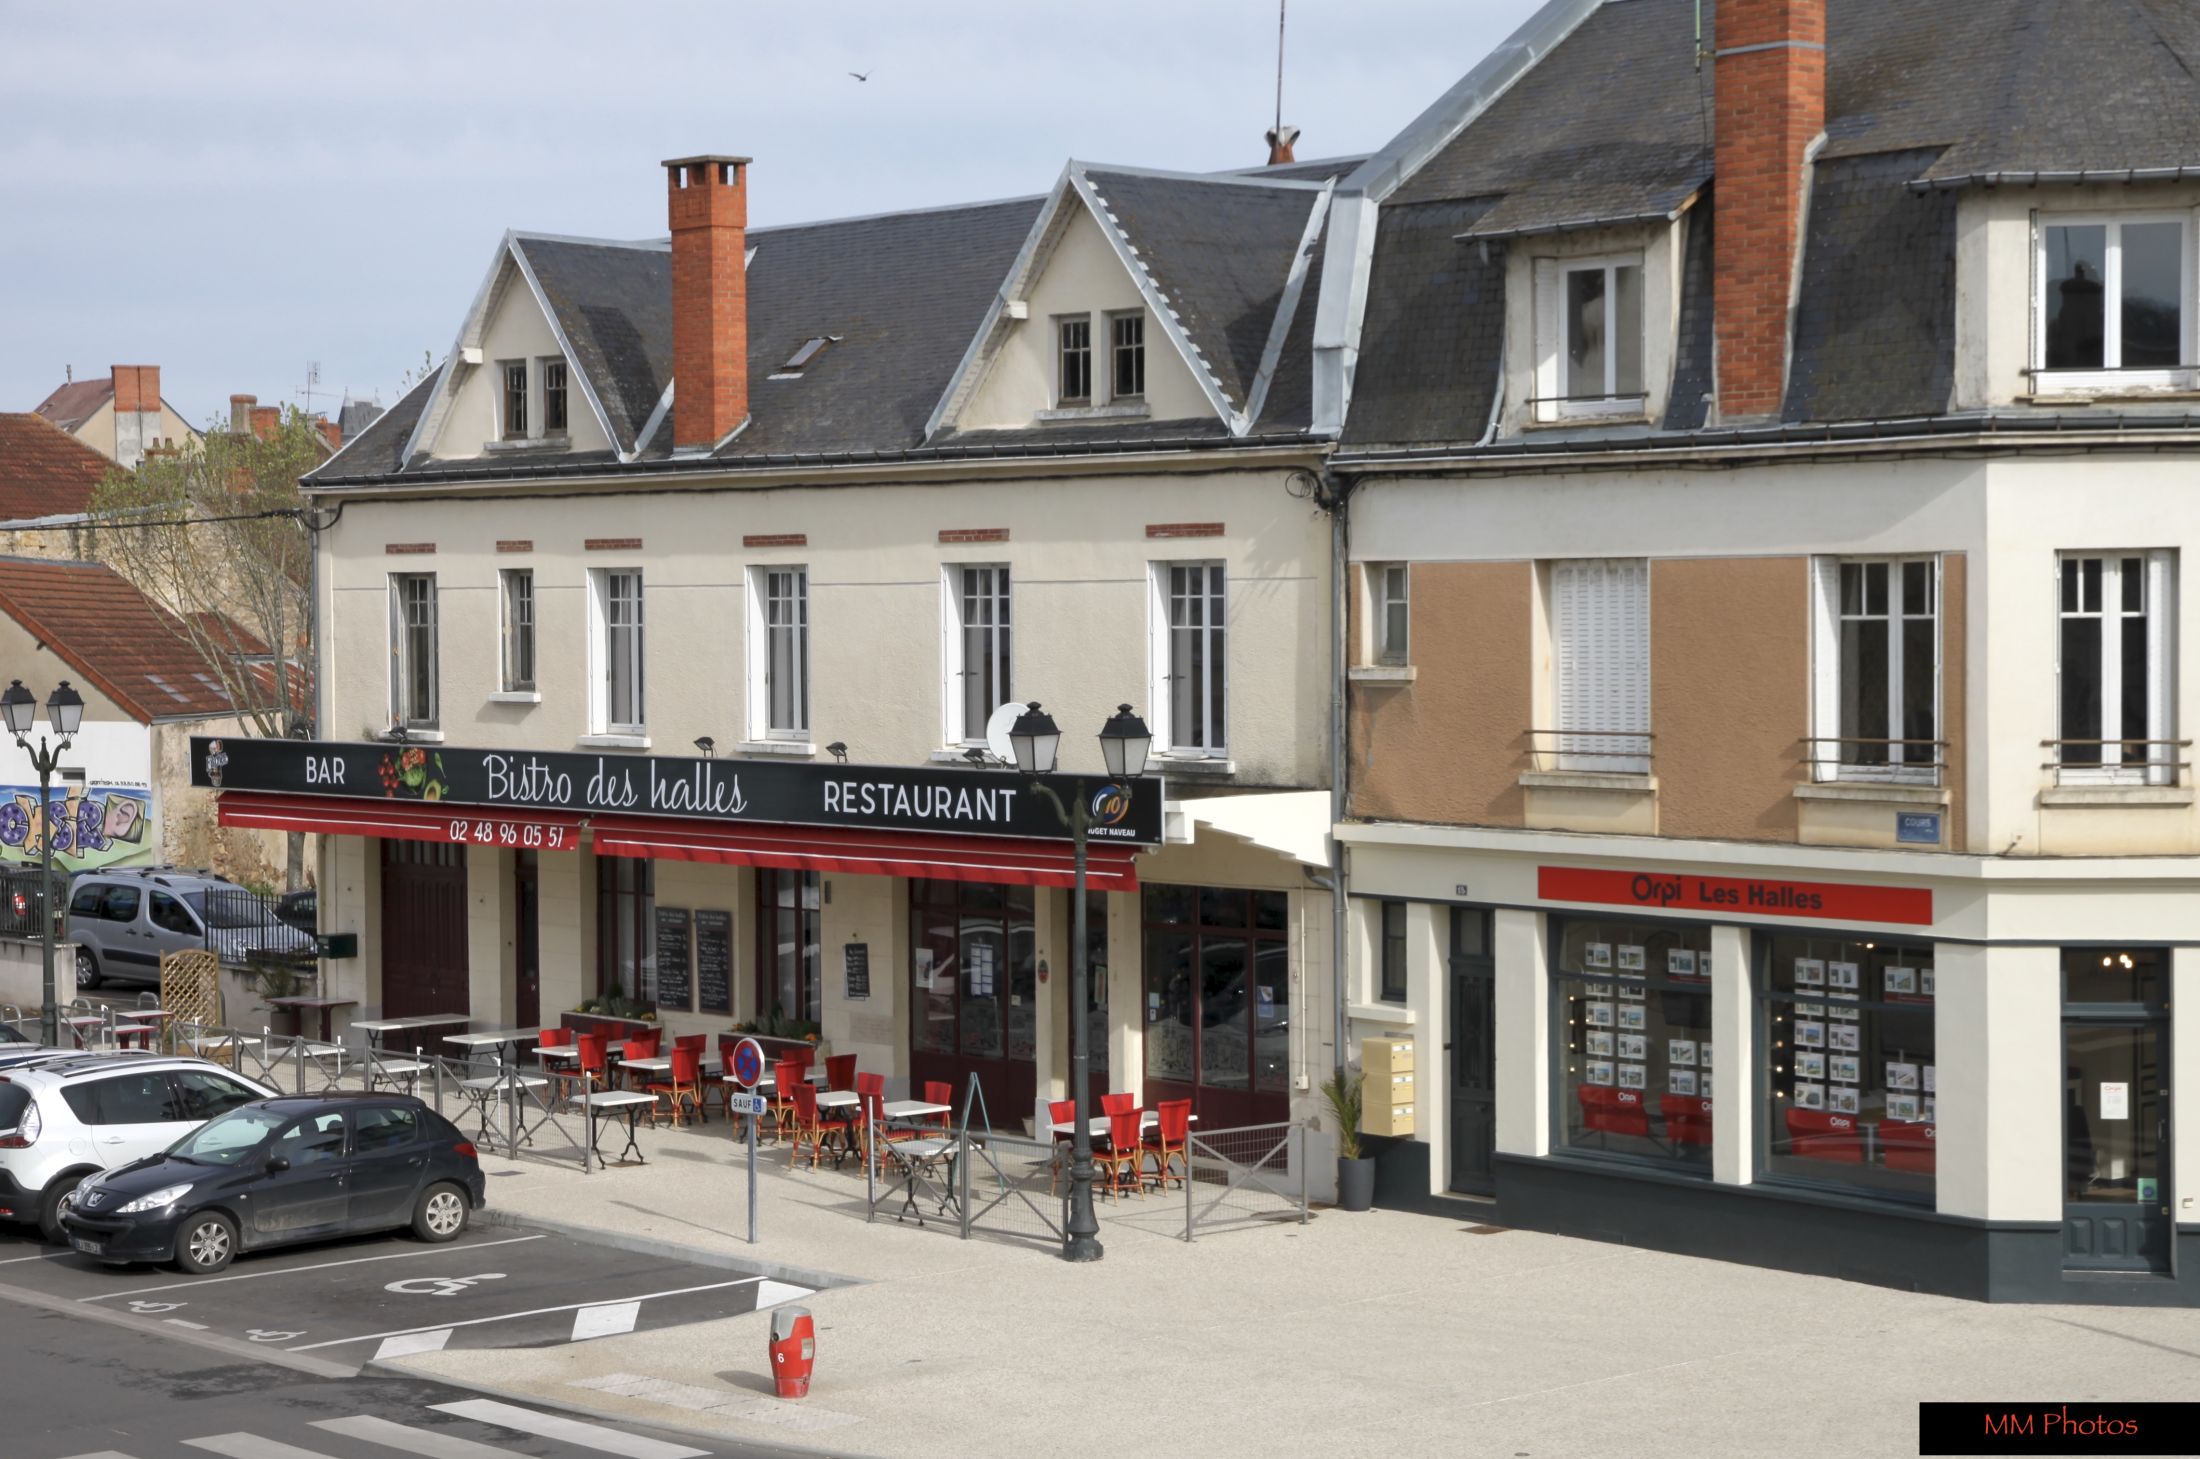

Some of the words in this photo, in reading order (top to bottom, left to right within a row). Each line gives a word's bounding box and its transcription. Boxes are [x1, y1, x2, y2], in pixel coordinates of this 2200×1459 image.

[306, 756, 345, 785] BAR
[482, 754, 572, 804] Bistro
[587, 757, 639, 807] des
[651, 758, 747, 814] halles
[824, 780, 1017, 822] RESTAURANT
[450, 820, 468, 841] 02
[474, 822, 493, 843] 48
[499, 823, 517, 844] 96
[523, 825, 542, 847] 05
[1109, 828, 1136, 837] NAVEAU
[1632, 874, 1682, 908] Orpi
[1699, 882, 1740, 905] Les
[1748, 885, 1824, 911] Halles
[733, 1098, 752, 1109] SAUF
[777, 1352, 785, 1363] 6
